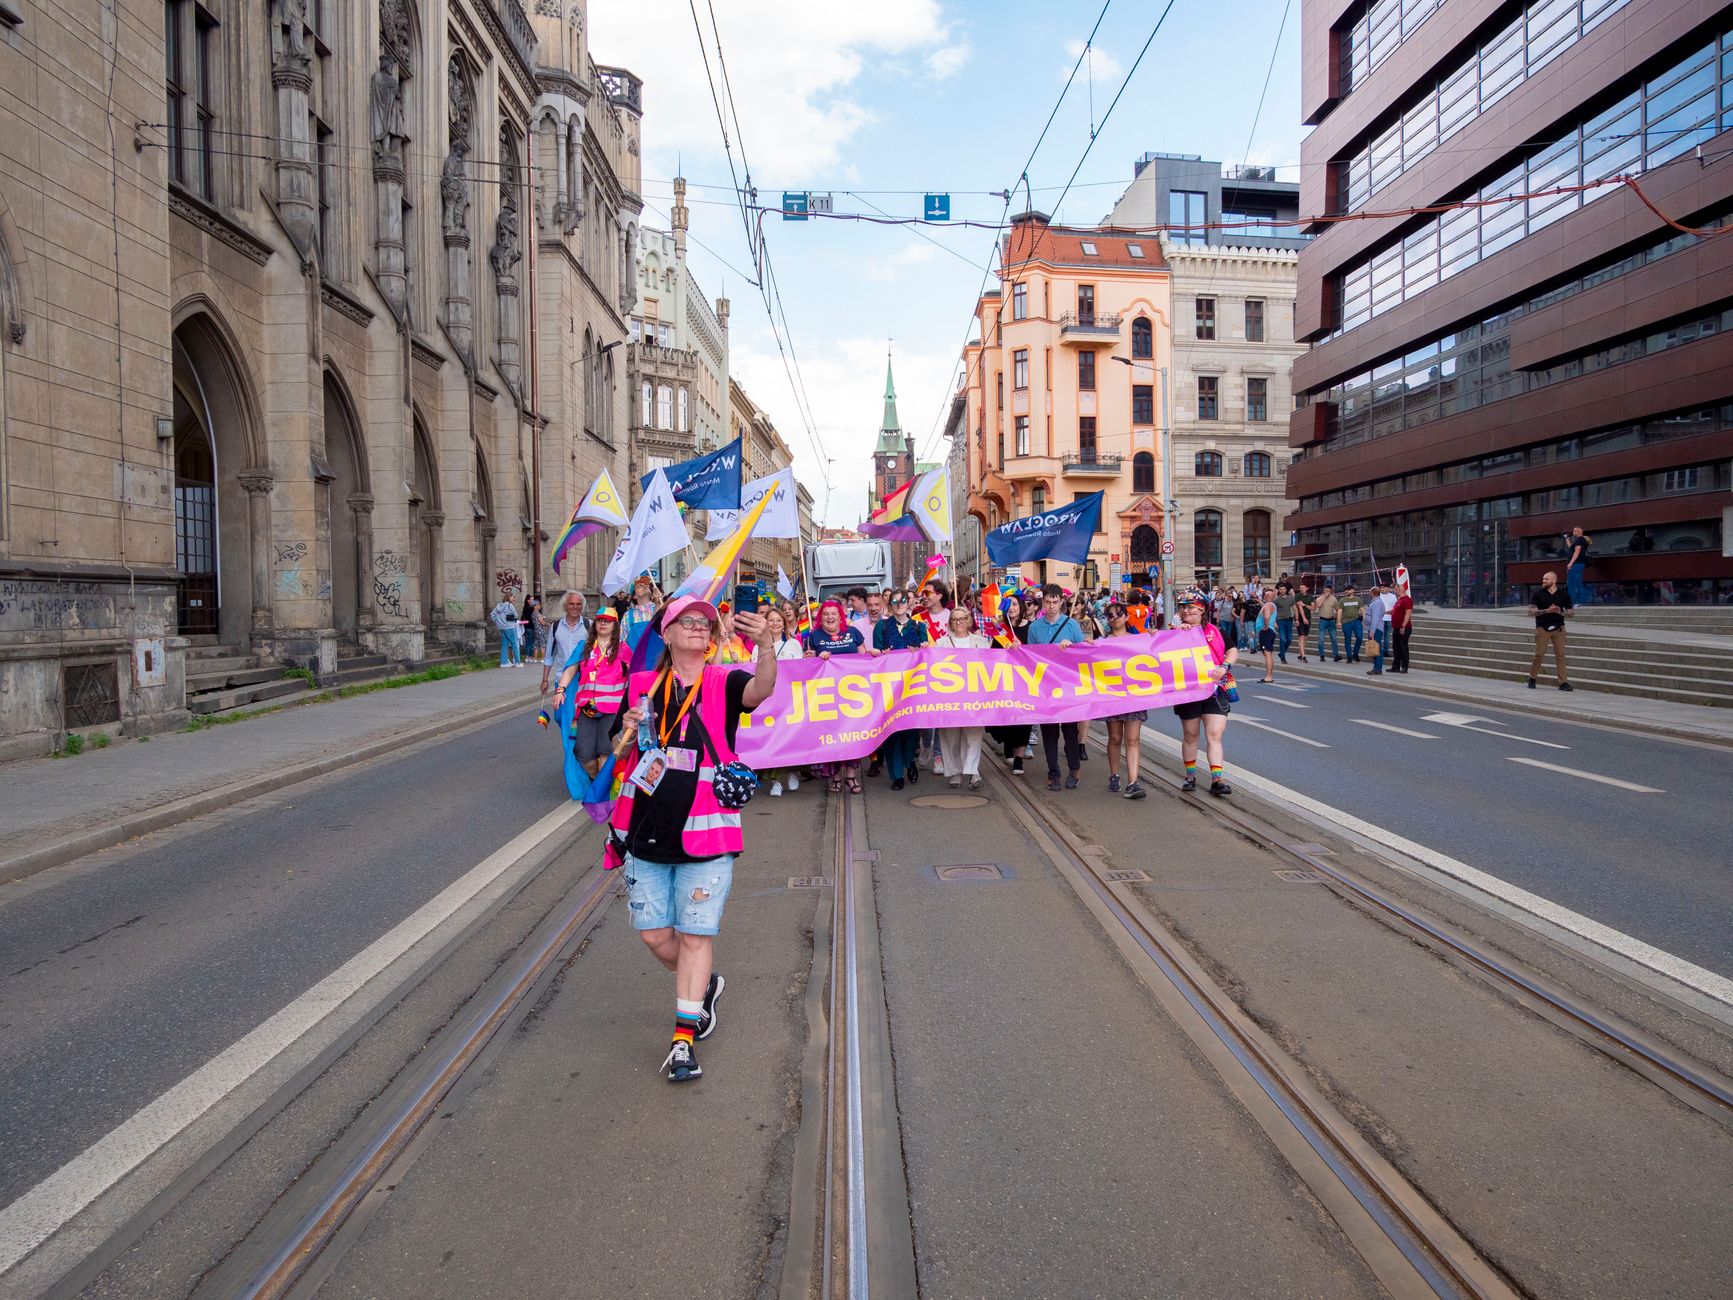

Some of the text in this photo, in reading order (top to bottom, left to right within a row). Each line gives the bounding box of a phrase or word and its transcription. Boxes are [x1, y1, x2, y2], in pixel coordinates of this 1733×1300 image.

[809, 200, 829, 209] K 11
[785, 654, 1064, 725] JESTEŚMY.
[818, 699, 1036, 746] 18. WROCŁAWSKI MARSZ RÓWNOŚCI
